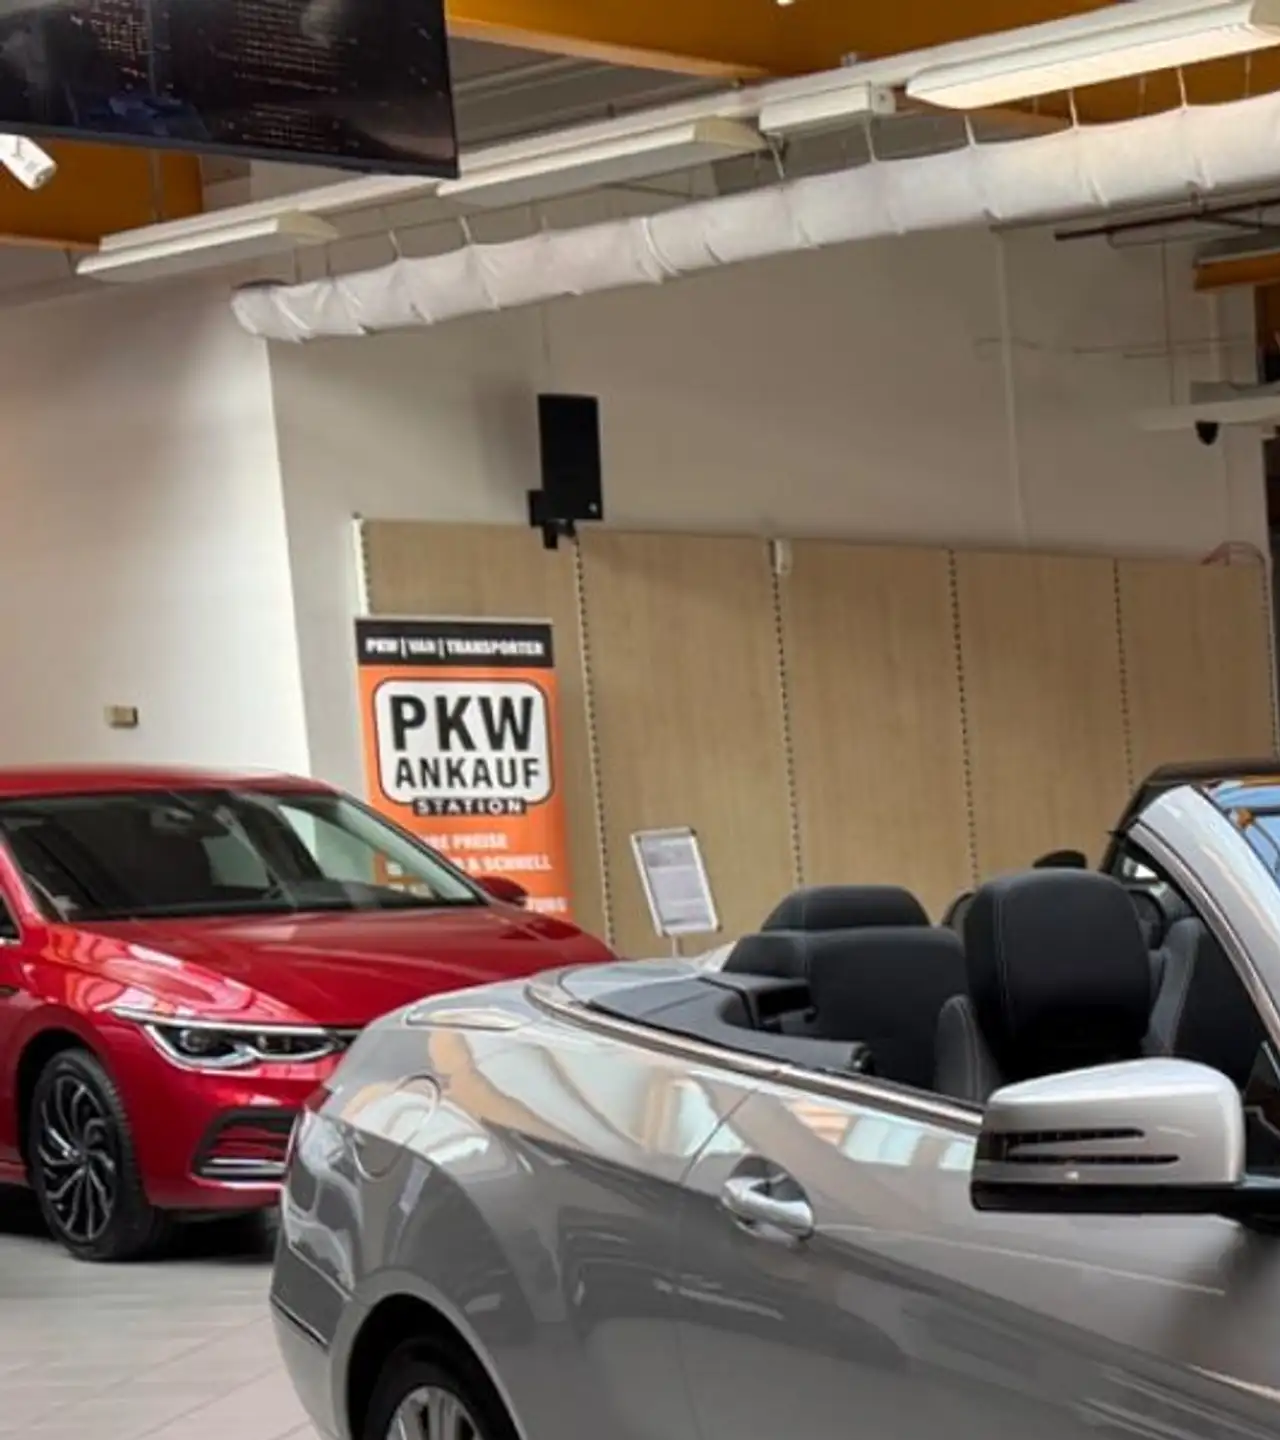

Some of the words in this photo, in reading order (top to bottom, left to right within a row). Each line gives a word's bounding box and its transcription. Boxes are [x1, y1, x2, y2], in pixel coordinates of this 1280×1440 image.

[389, 694, 534, 751] PKW
[396, 757, 540, 789] ANKAUF
[416, 799, 522, 815] STATION
